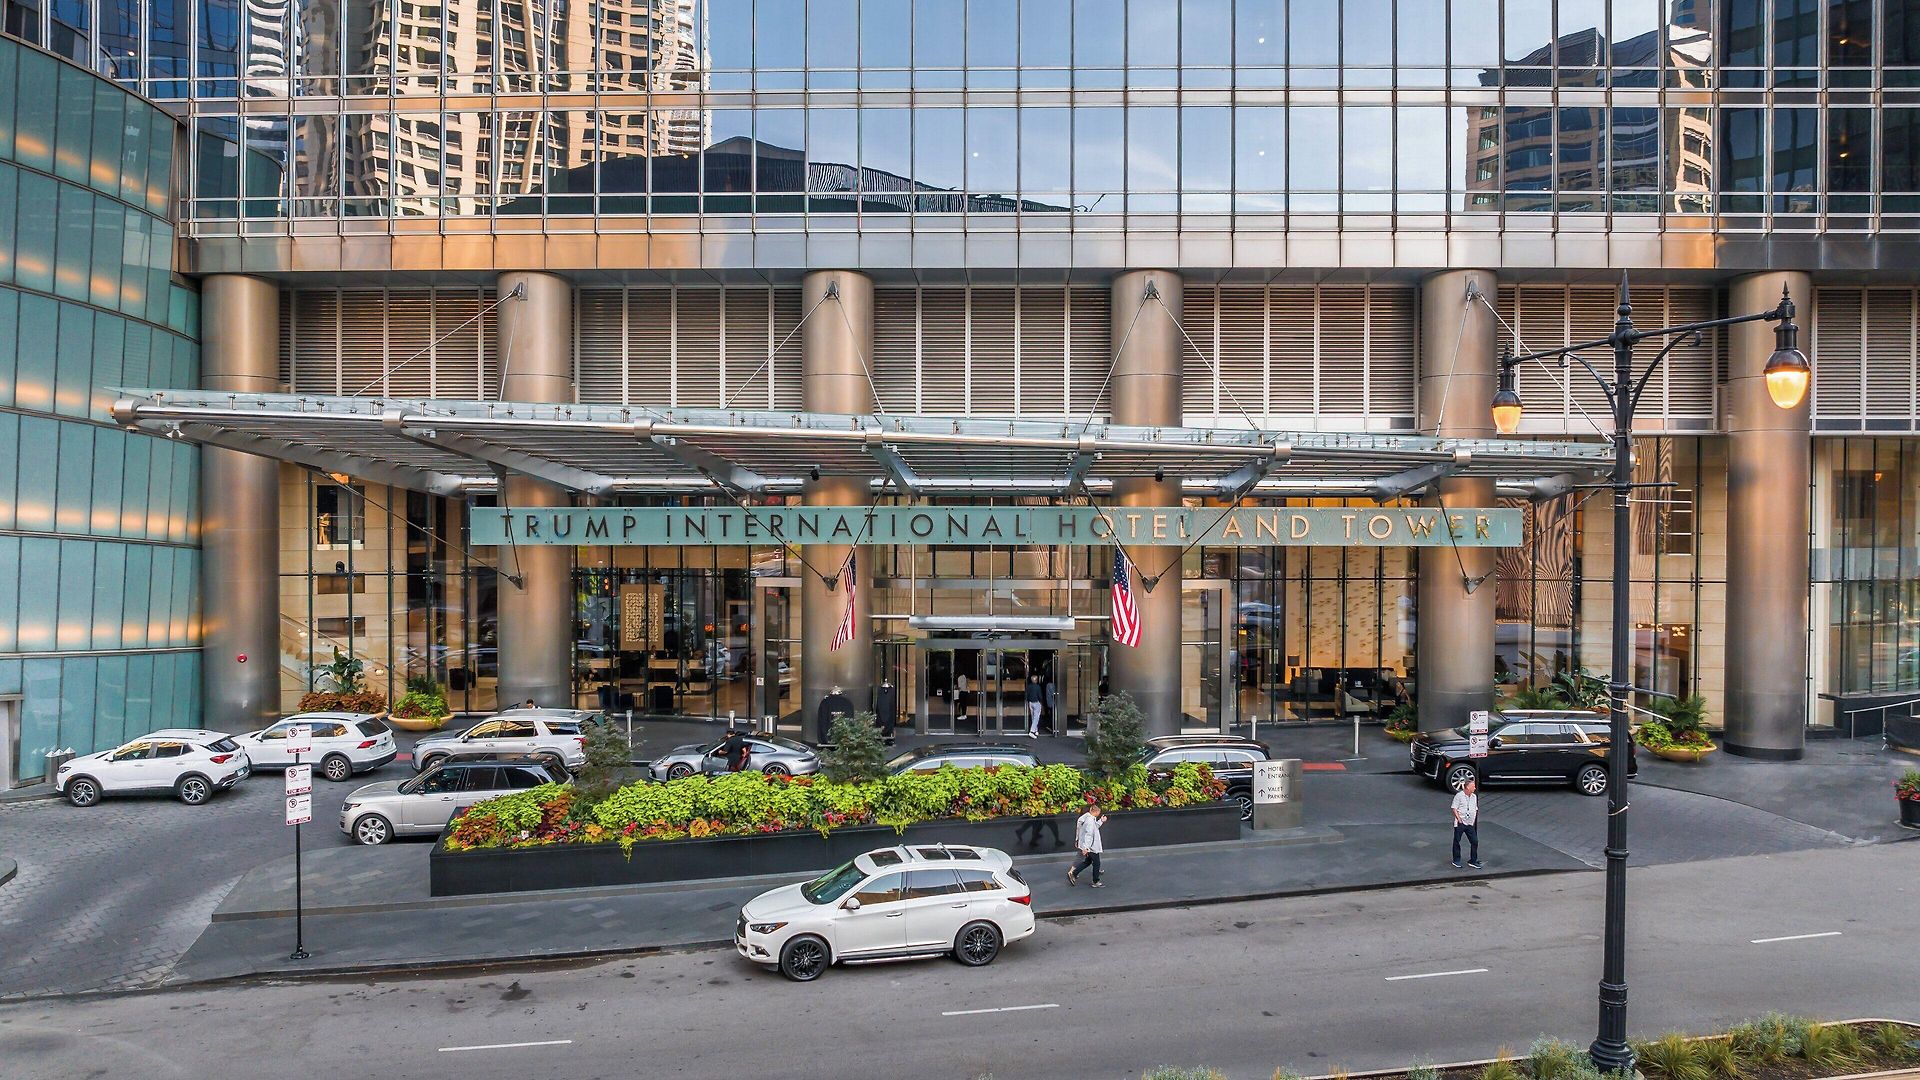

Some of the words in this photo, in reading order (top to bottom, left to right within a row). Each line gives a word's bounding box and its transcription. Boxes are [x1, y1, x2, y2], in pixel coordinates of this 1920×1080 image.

[500, 514, 636, 538] TRUMP
[666, 513, 1027, 538] INTERNATIONAL
[1058, 513, 1191, 539] HOTEL
[1222, 514, 1310, 539] AND
[1341, 514, 1491, 540] TOWER
